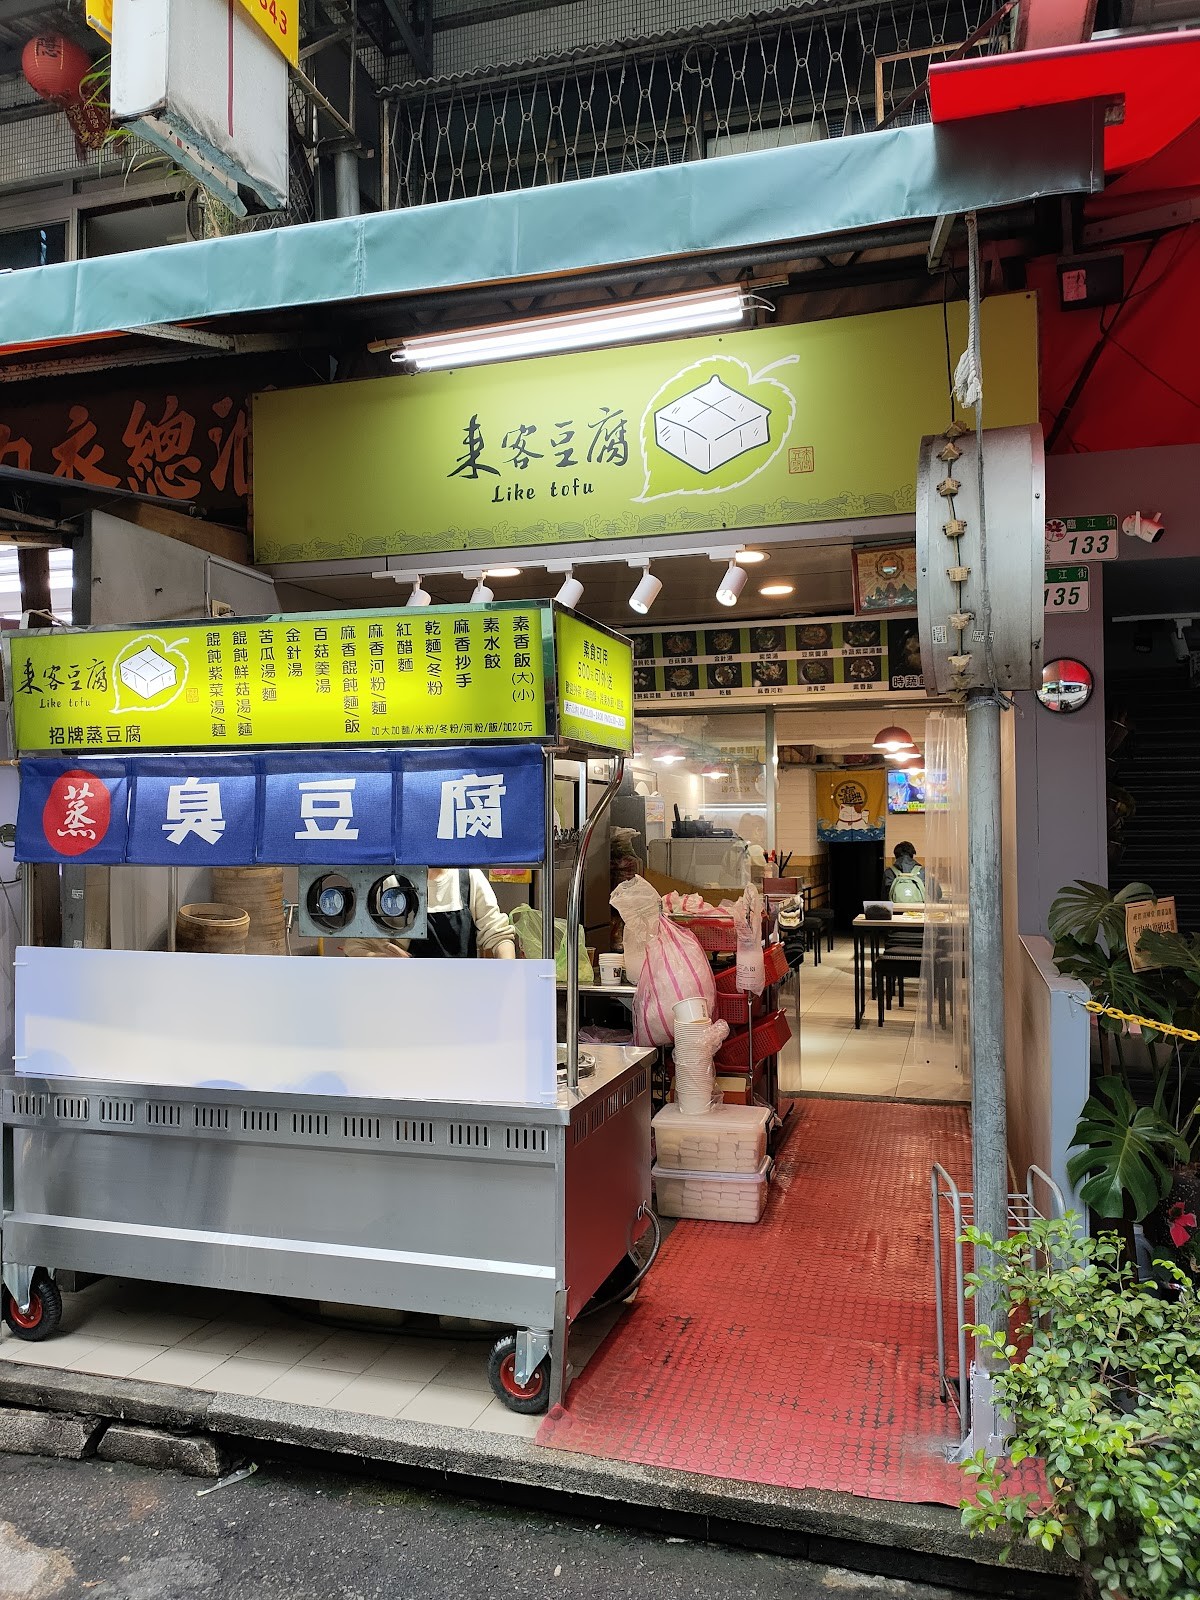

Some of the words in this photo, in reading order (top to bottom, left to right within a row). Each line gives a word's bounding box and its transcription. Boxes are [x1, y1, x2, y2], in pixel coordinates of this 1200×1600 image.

[491, 483, 536, 503] Like
[550, 478, 595, 499] tofu
[1066, 516, 1116, 530] 臨江街
[1068, 534, 1110, 555] 133
[259, 629, 278, 701] 苦瓜湯/麵
[285, 627, 303, 678] 金針湯
[395, 622, 414, 673] 紅醋麵
[424, 620, 443, 696] 乾麵/冬粉
[453, 618, 472, 688] 麻香抄手
[482, 617, 501, 669] 素水餃
[583, 640, 608, 666] 素食可用
[368, 623, 388, 716] 麻香河粉/麵
[40, 697, 62, 709] Like
[69, 696, 91, 708] tofu
[49, 724, 142, 745] 招牌蒸豆腐
[56, 782, 97, 840] 蒸
[162, 773, 507, 846] 臭豆腐
